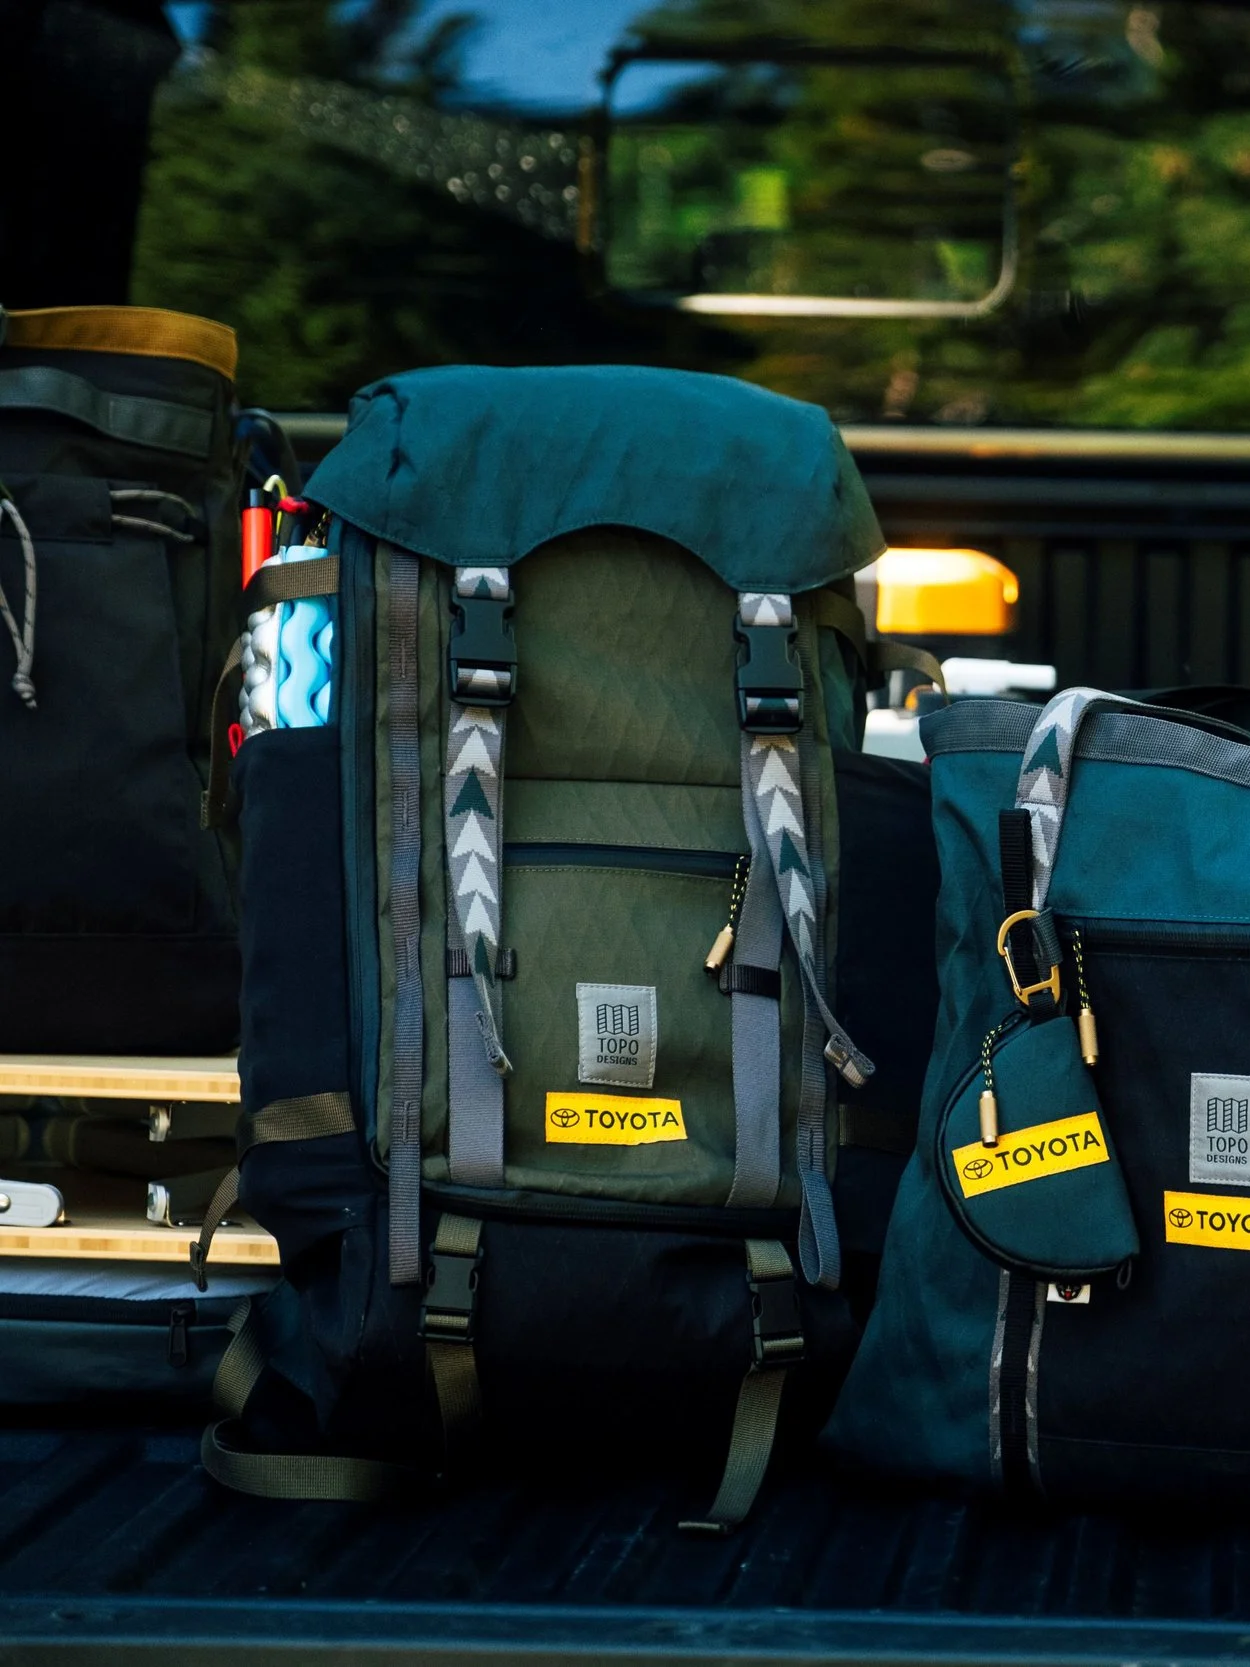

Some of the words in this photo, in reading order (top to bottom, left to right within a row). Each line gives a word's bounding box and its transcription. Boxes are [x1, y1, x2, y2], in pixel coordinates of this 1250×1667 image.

[597, 1038, 639, 1055] TOPO
[596, 1055, 637, 1066] DESIGNS
[584, 1109, 679, 1130] TOYOTA
[995, 1130, 1100, 1171] TOYOTA
[1206, 1136, 1248, 1154] TOPO
[1206, 1154, 1248, 1165] DESIGNS
